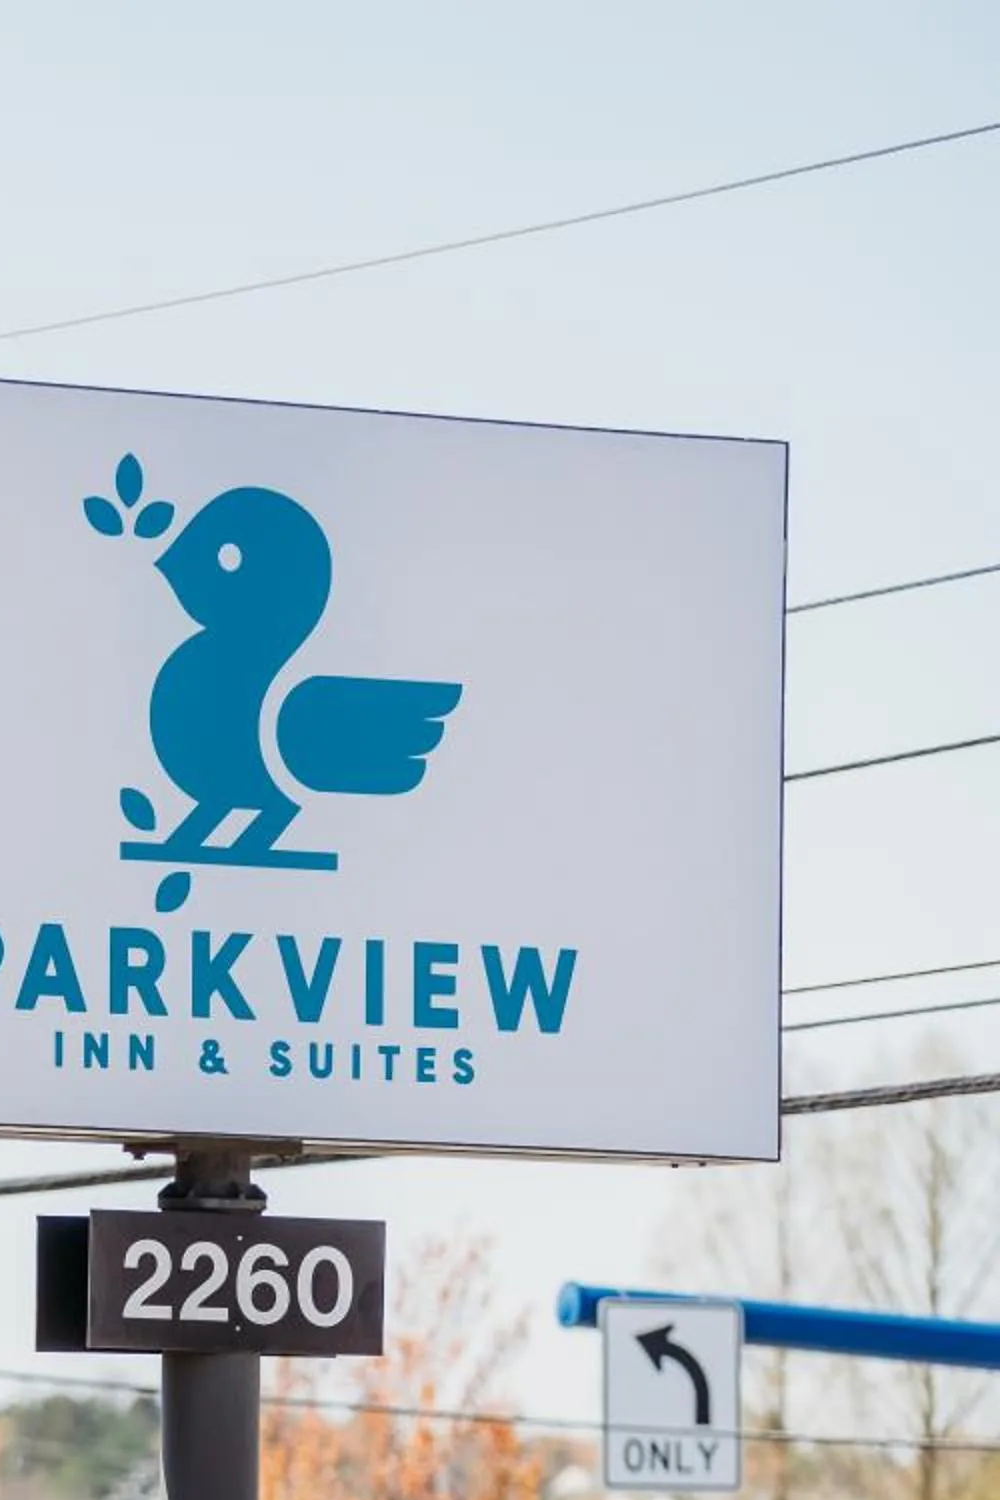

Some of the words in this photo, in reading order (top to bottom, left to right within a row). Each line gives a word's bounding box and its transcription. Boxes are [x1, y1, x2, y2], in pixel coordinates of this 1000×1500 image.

[54, 1031, 155, 1071] INN
[200, 1039, 229, 1075] &
[269, 1040, 475, 1085] SUITES
[122, 1238, 354, 1327] 2260
[623, 1437, 719, 1474] ONLY
